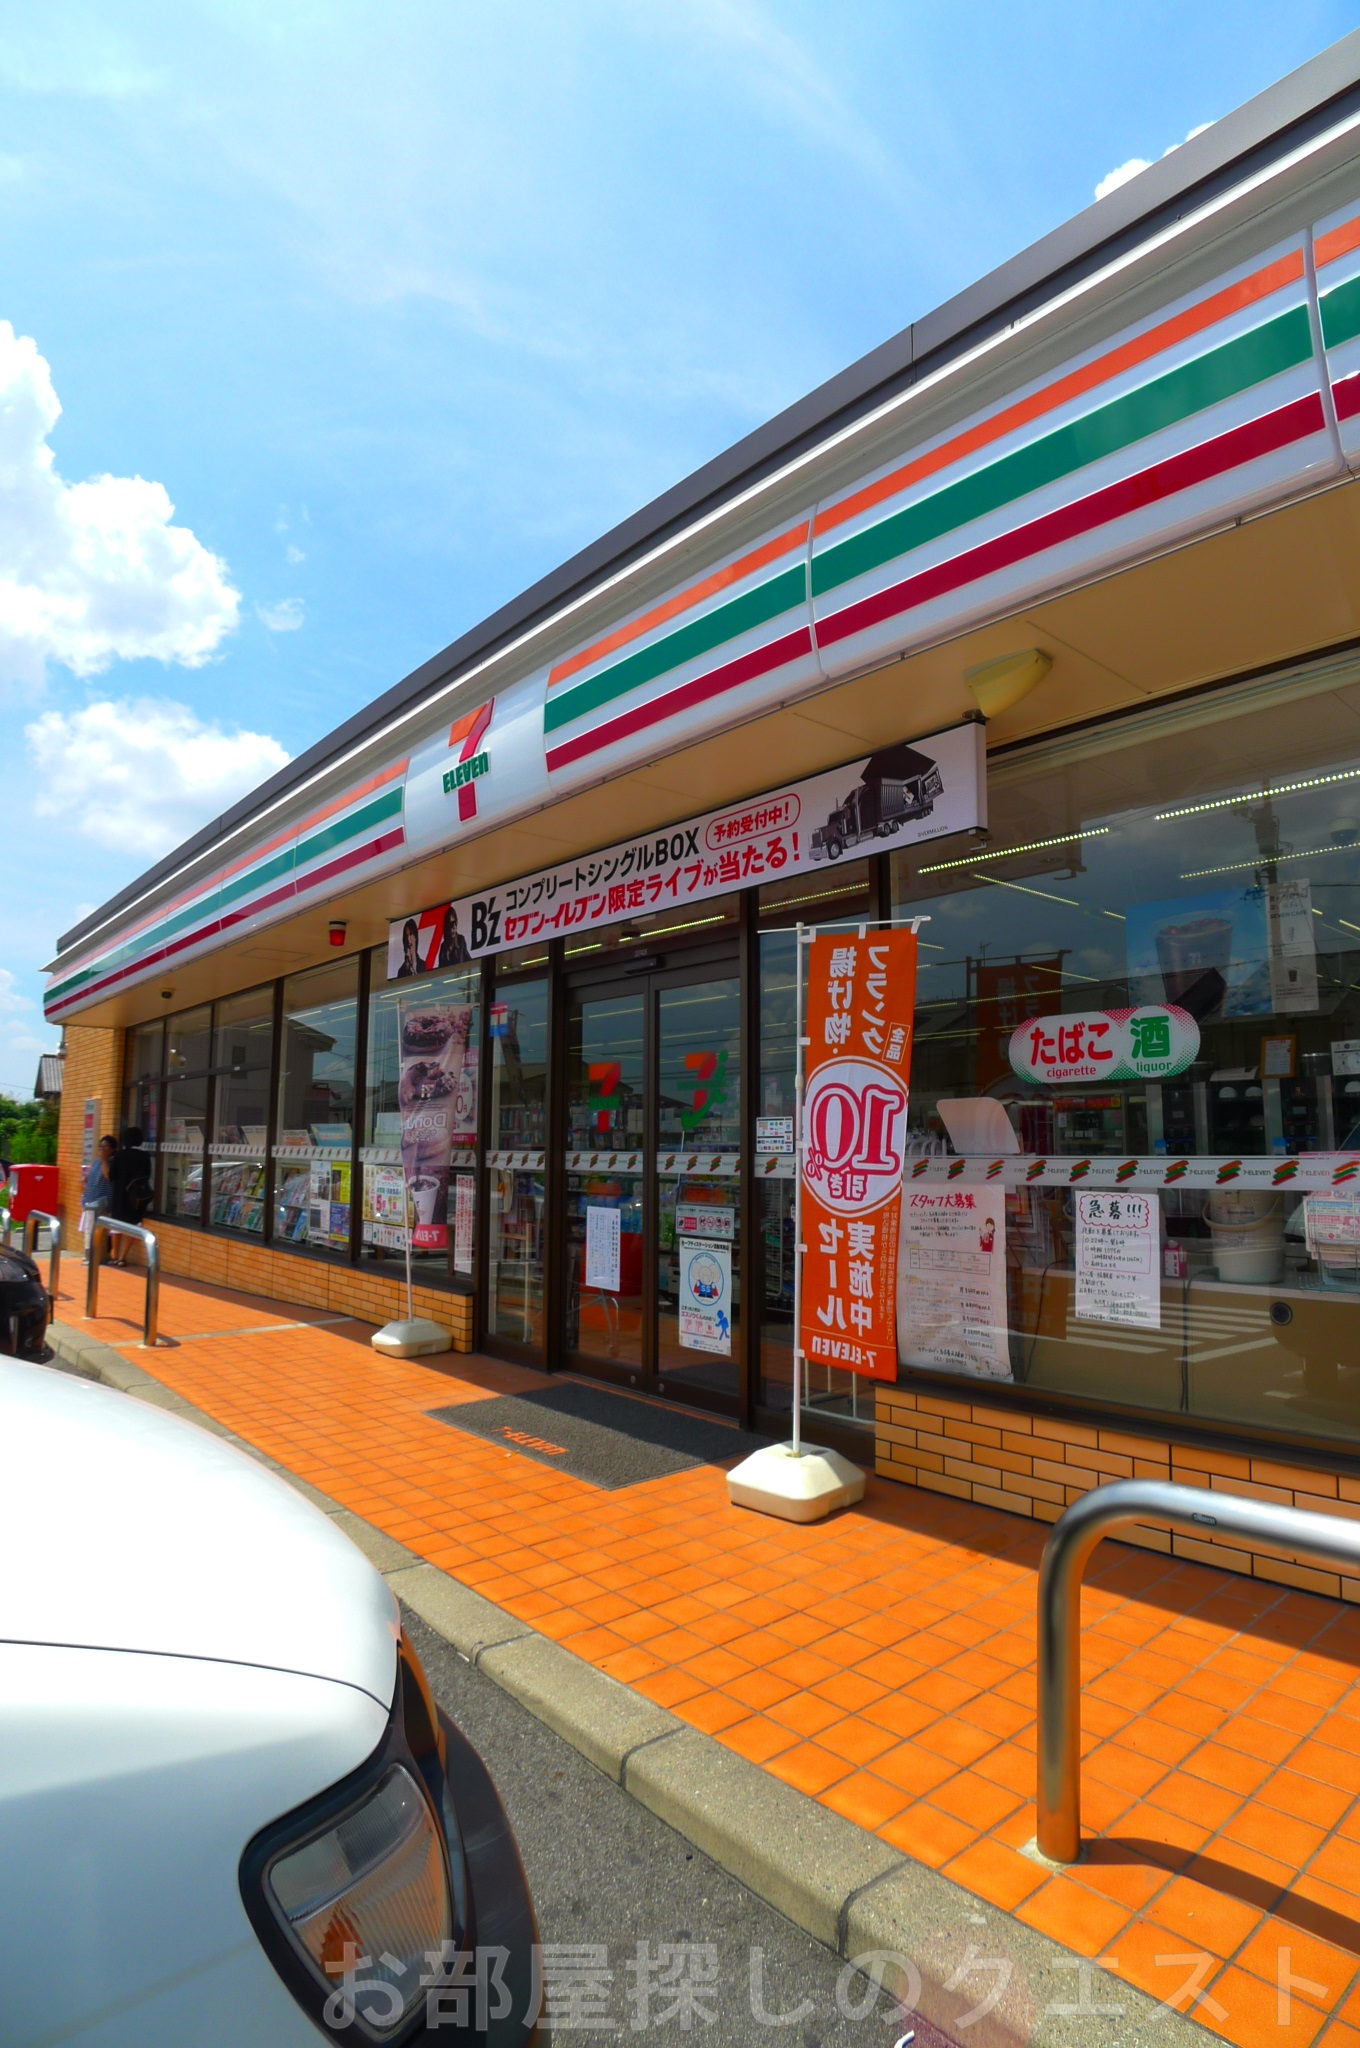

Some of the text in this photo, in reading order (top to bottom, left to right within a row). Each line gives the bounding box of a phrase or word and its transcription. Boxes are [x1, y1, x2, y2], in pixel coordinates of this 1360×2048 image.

[714, 801, 793, 843] 予約受付中!
[505, 827, 699, 913] コンプリートシングルBOX
[471, 896, 502, 951] B'z
[1030, 1015, 1171, 1066] たばこ 酒
[1046, 1060, 1172, 1079] cigarette liquor
[909, 1193, 977, 1209] スタッフ大募集
